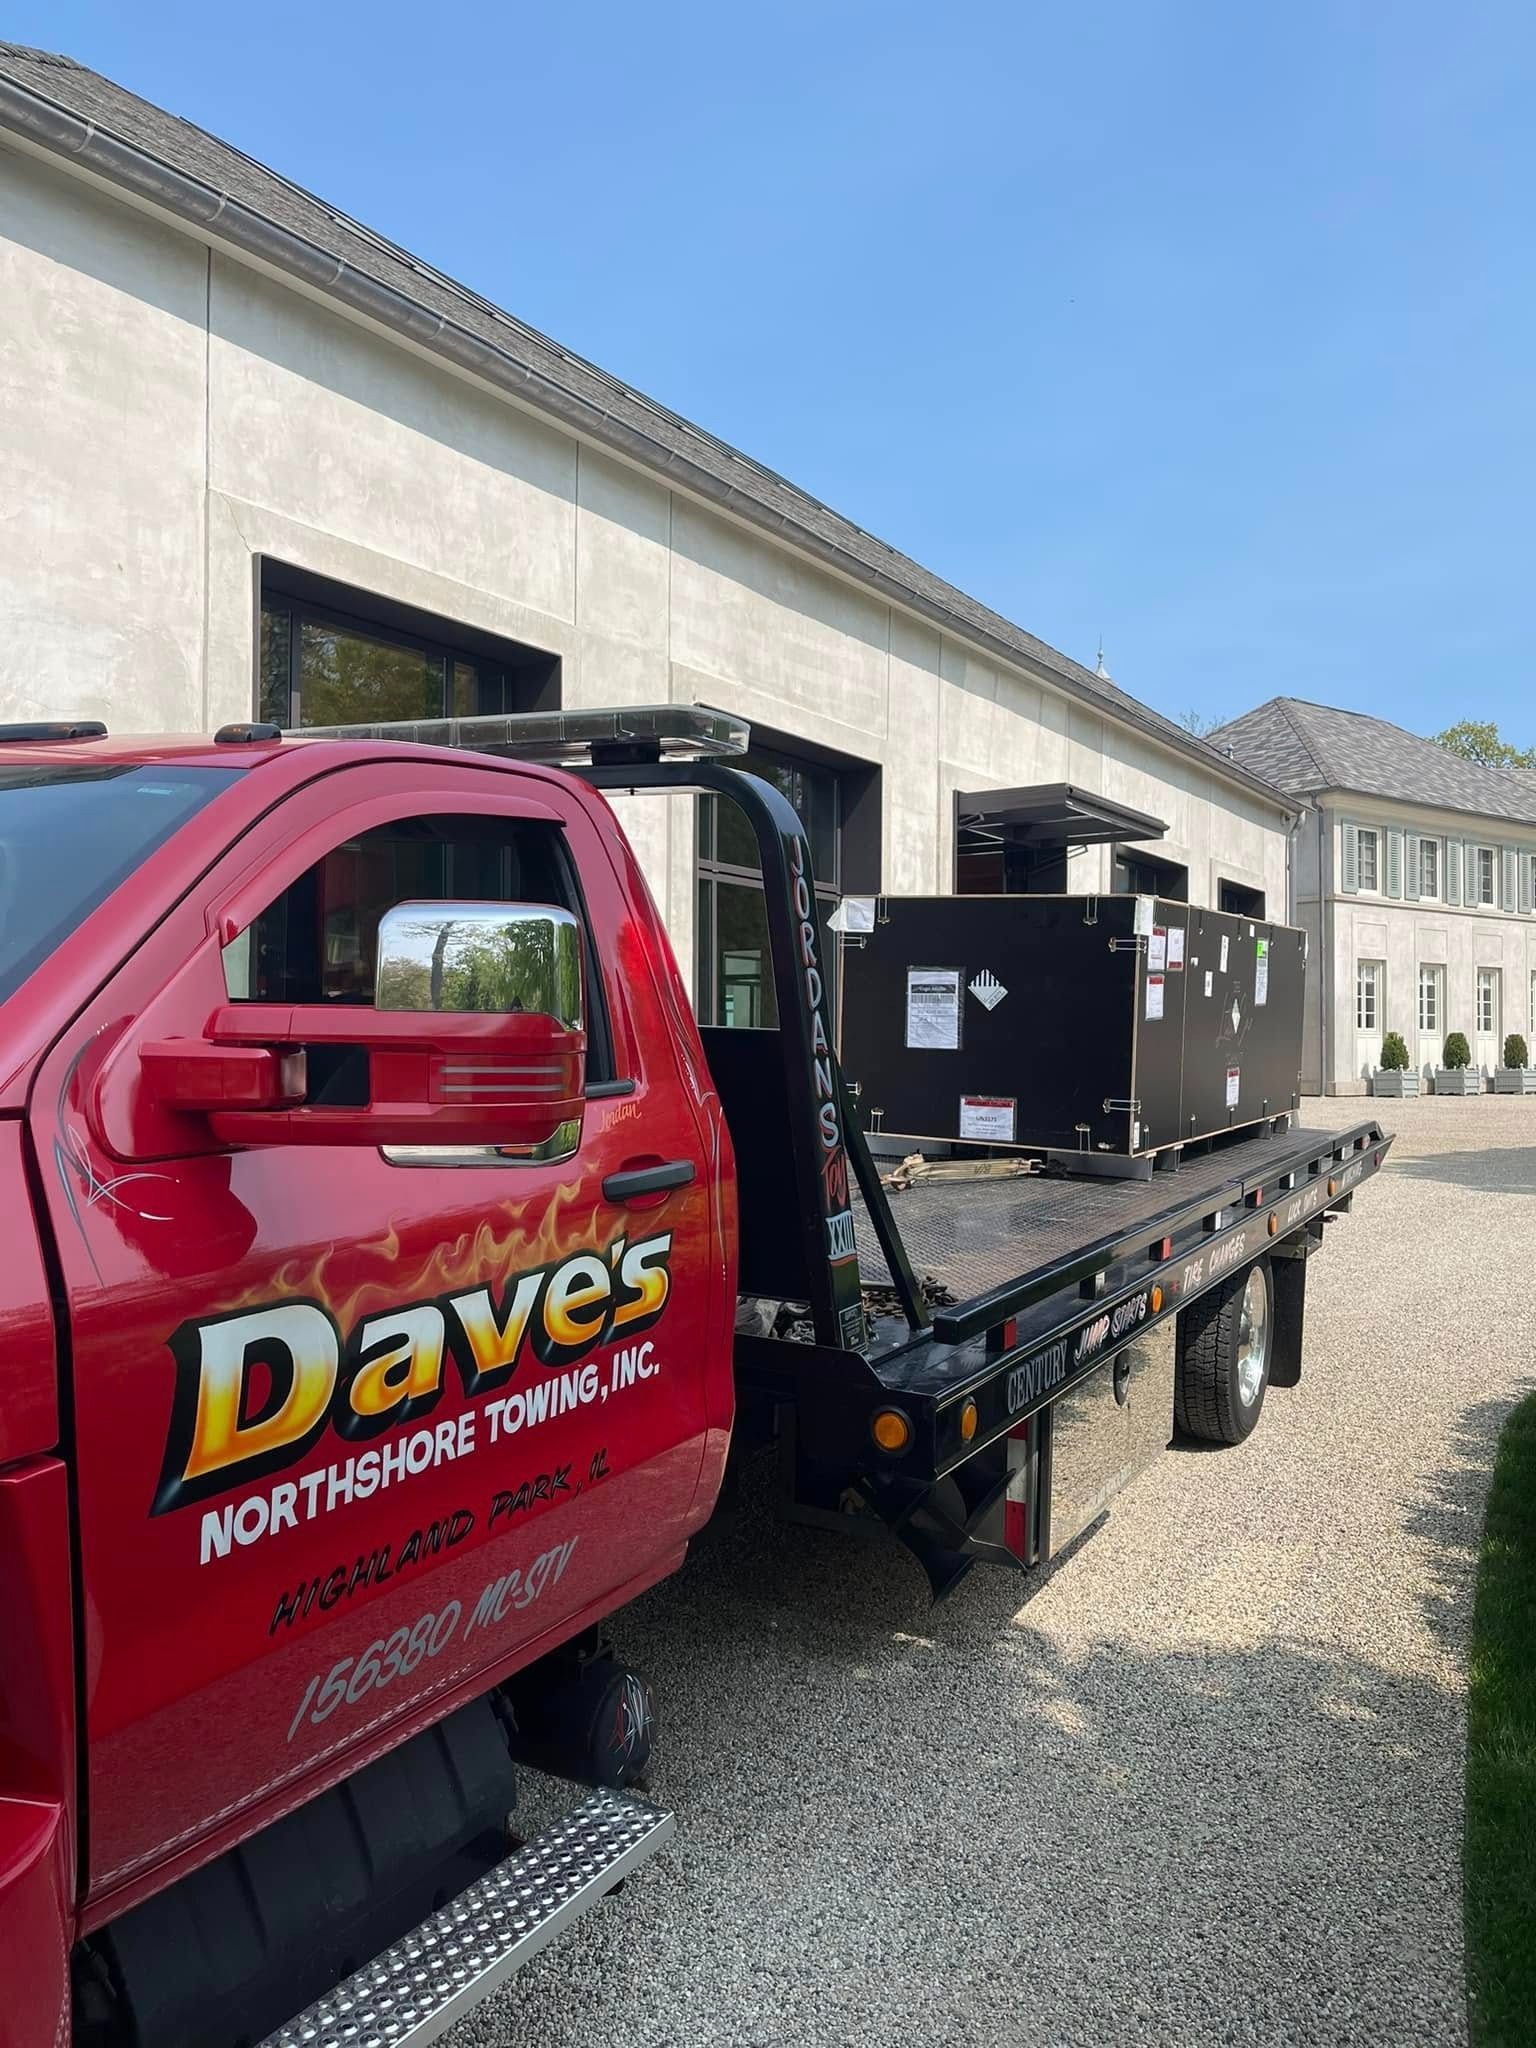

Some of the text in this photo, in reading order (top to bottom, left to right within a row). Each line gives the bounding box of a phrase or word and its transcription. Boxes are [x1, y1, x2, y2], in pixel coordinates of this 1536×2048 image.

[791, 834, 839, 1147] JORDANS
[165, 1230, 674, 1495] Dave's
[1007, 1338, 1068, 1414] CENTURY
[1073, 1314, 1110, 1366] JUMP
[1111, 1292, 1148, 1338] STARTS
[1183, 1257, 1204, 1294] TIRE
[200, 1411, 476, 1565] NORTHSHORE
[268, 1509, 475, 1636] HIGHLAND
[589, 1448, 611, 1483] IL
[287, 1600, 462, 1743] 156380
